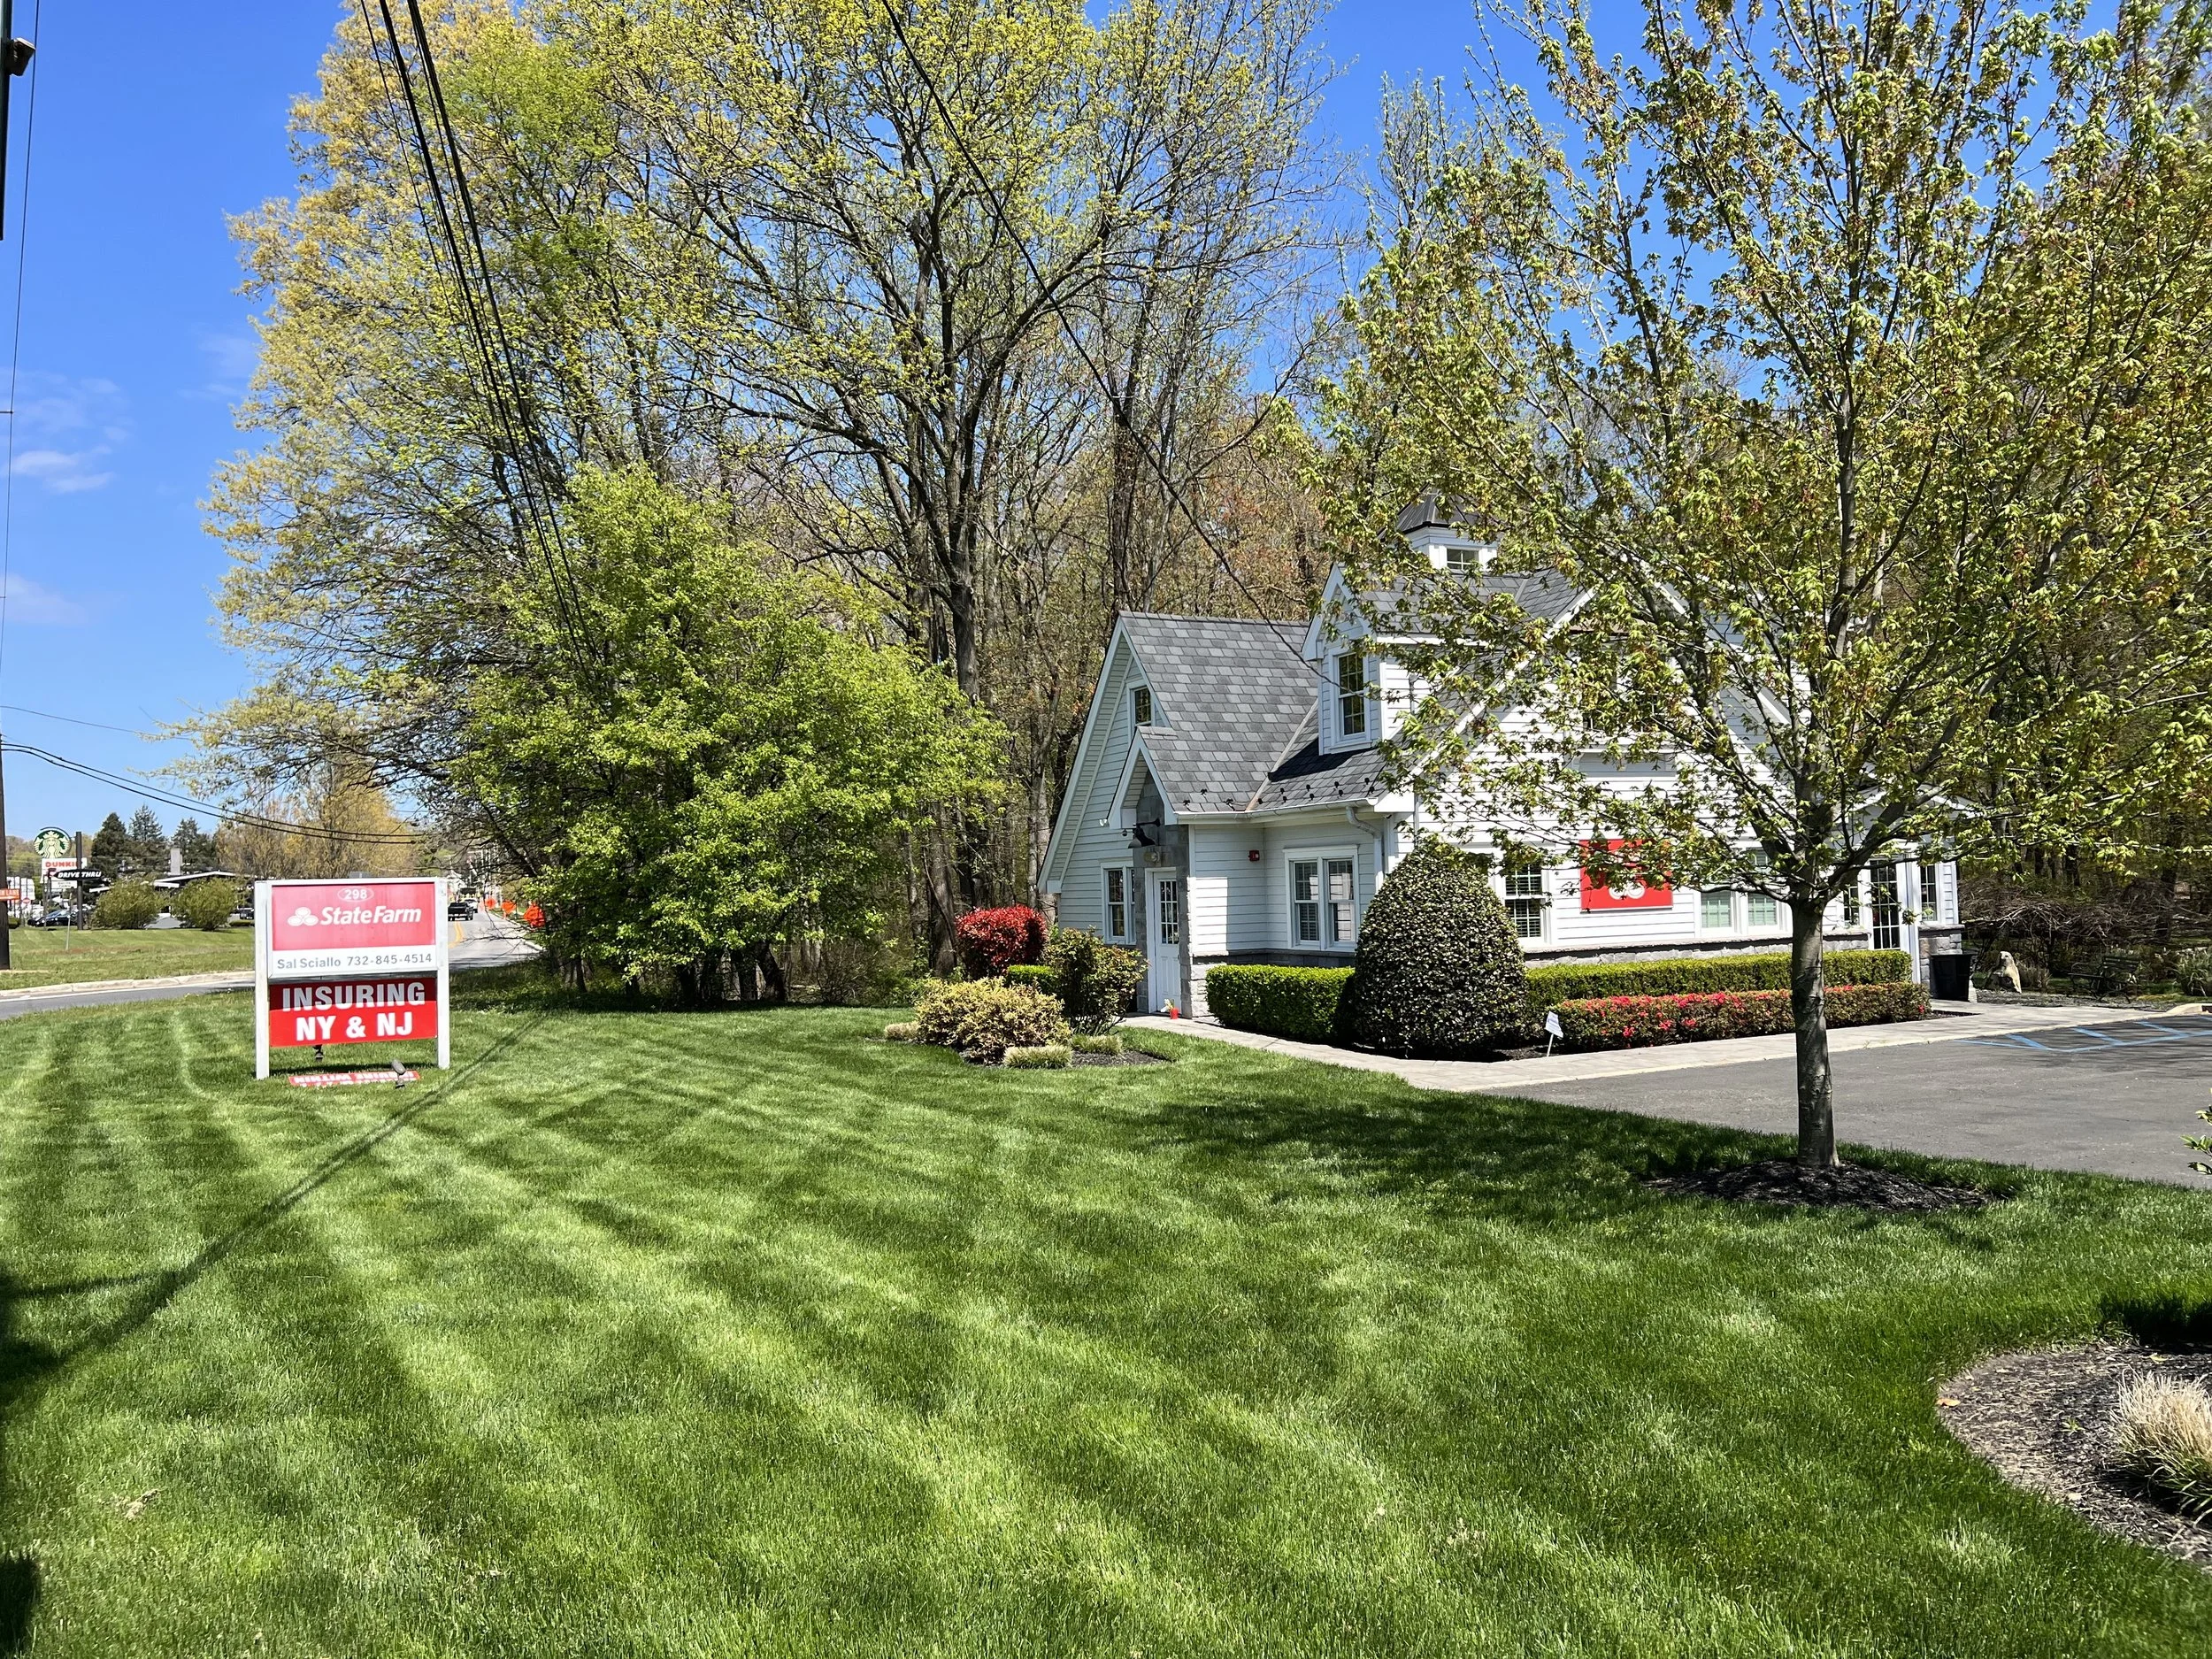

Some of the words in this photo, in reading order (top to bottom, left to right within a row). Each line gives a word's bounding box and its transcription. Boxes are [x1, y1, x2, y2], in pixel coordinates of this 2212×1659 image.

[345, 888, 368, 901] 298
[277, 958, 297, 969] Sal
[300, 956, 342, 968] Sciallo
[347, 953, 433, 966] 732-845-4514
[282, 981, 426, 1012] INSURING
[296, 1015, 336, 1041] NY
[345, 1017, 366, 1039] &
[377, 1011, 413, 1037] NJ
